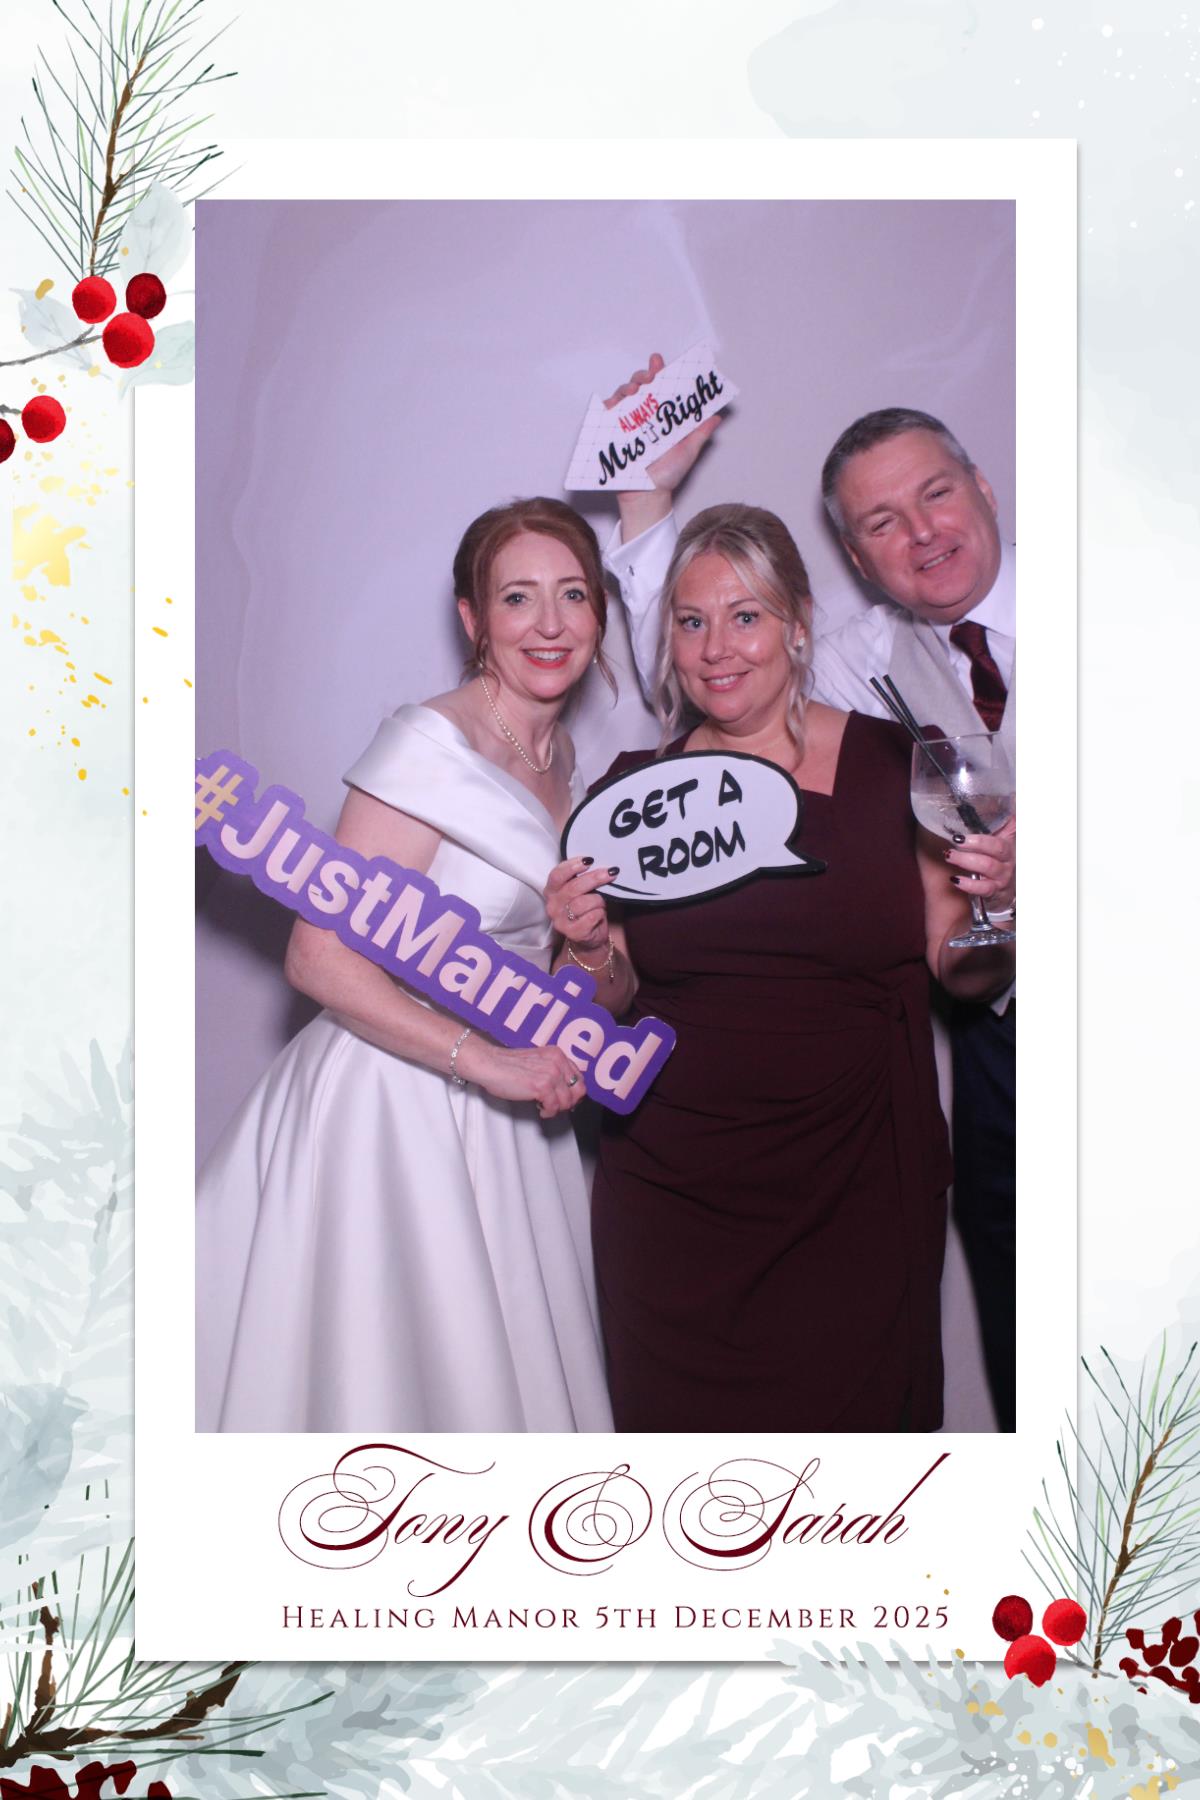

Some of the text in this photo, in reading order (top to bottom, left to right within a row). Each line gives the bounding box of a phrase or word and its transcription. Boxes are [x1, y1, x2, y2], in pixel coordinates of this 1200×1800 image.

[598, 370, 723, 486] Mrs Right
[618, 392, 660, 433] ALWAYS
[608, 769, 743, 839] GET A
[637, 820, 746, 881] ROOM
